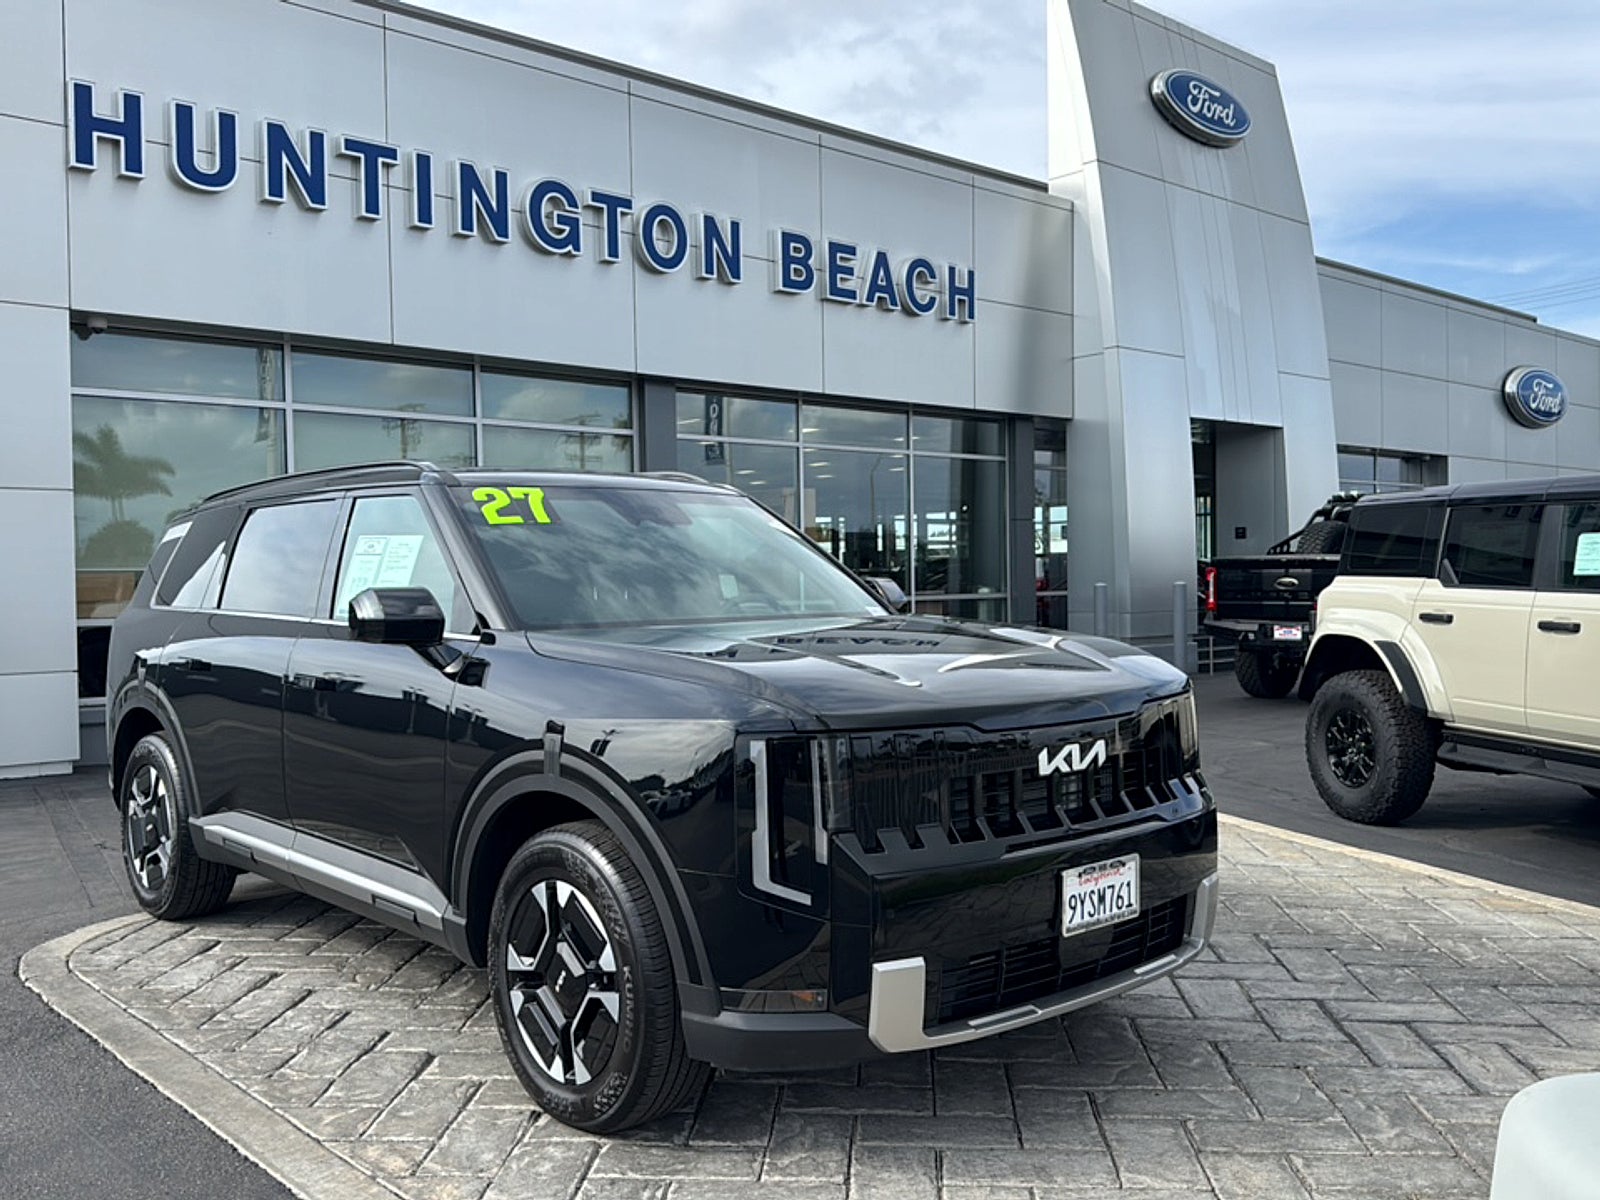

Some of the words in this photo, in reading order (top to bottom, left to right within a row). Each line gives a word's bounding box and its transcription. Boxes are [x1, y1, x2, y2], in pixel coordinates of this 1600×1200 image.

[1187, 81, 1236, 126] Ford
[69, 80, 742, 284] HUNTINGTON
[776, 229, 975, 322] BEACH
[1530, 378, 1561, 413] Ford
[472, 487, 552, 525] 27
[1038, 739, 1106, 776] KIA
[1068, 880, 1134, 925] 9YSM761
